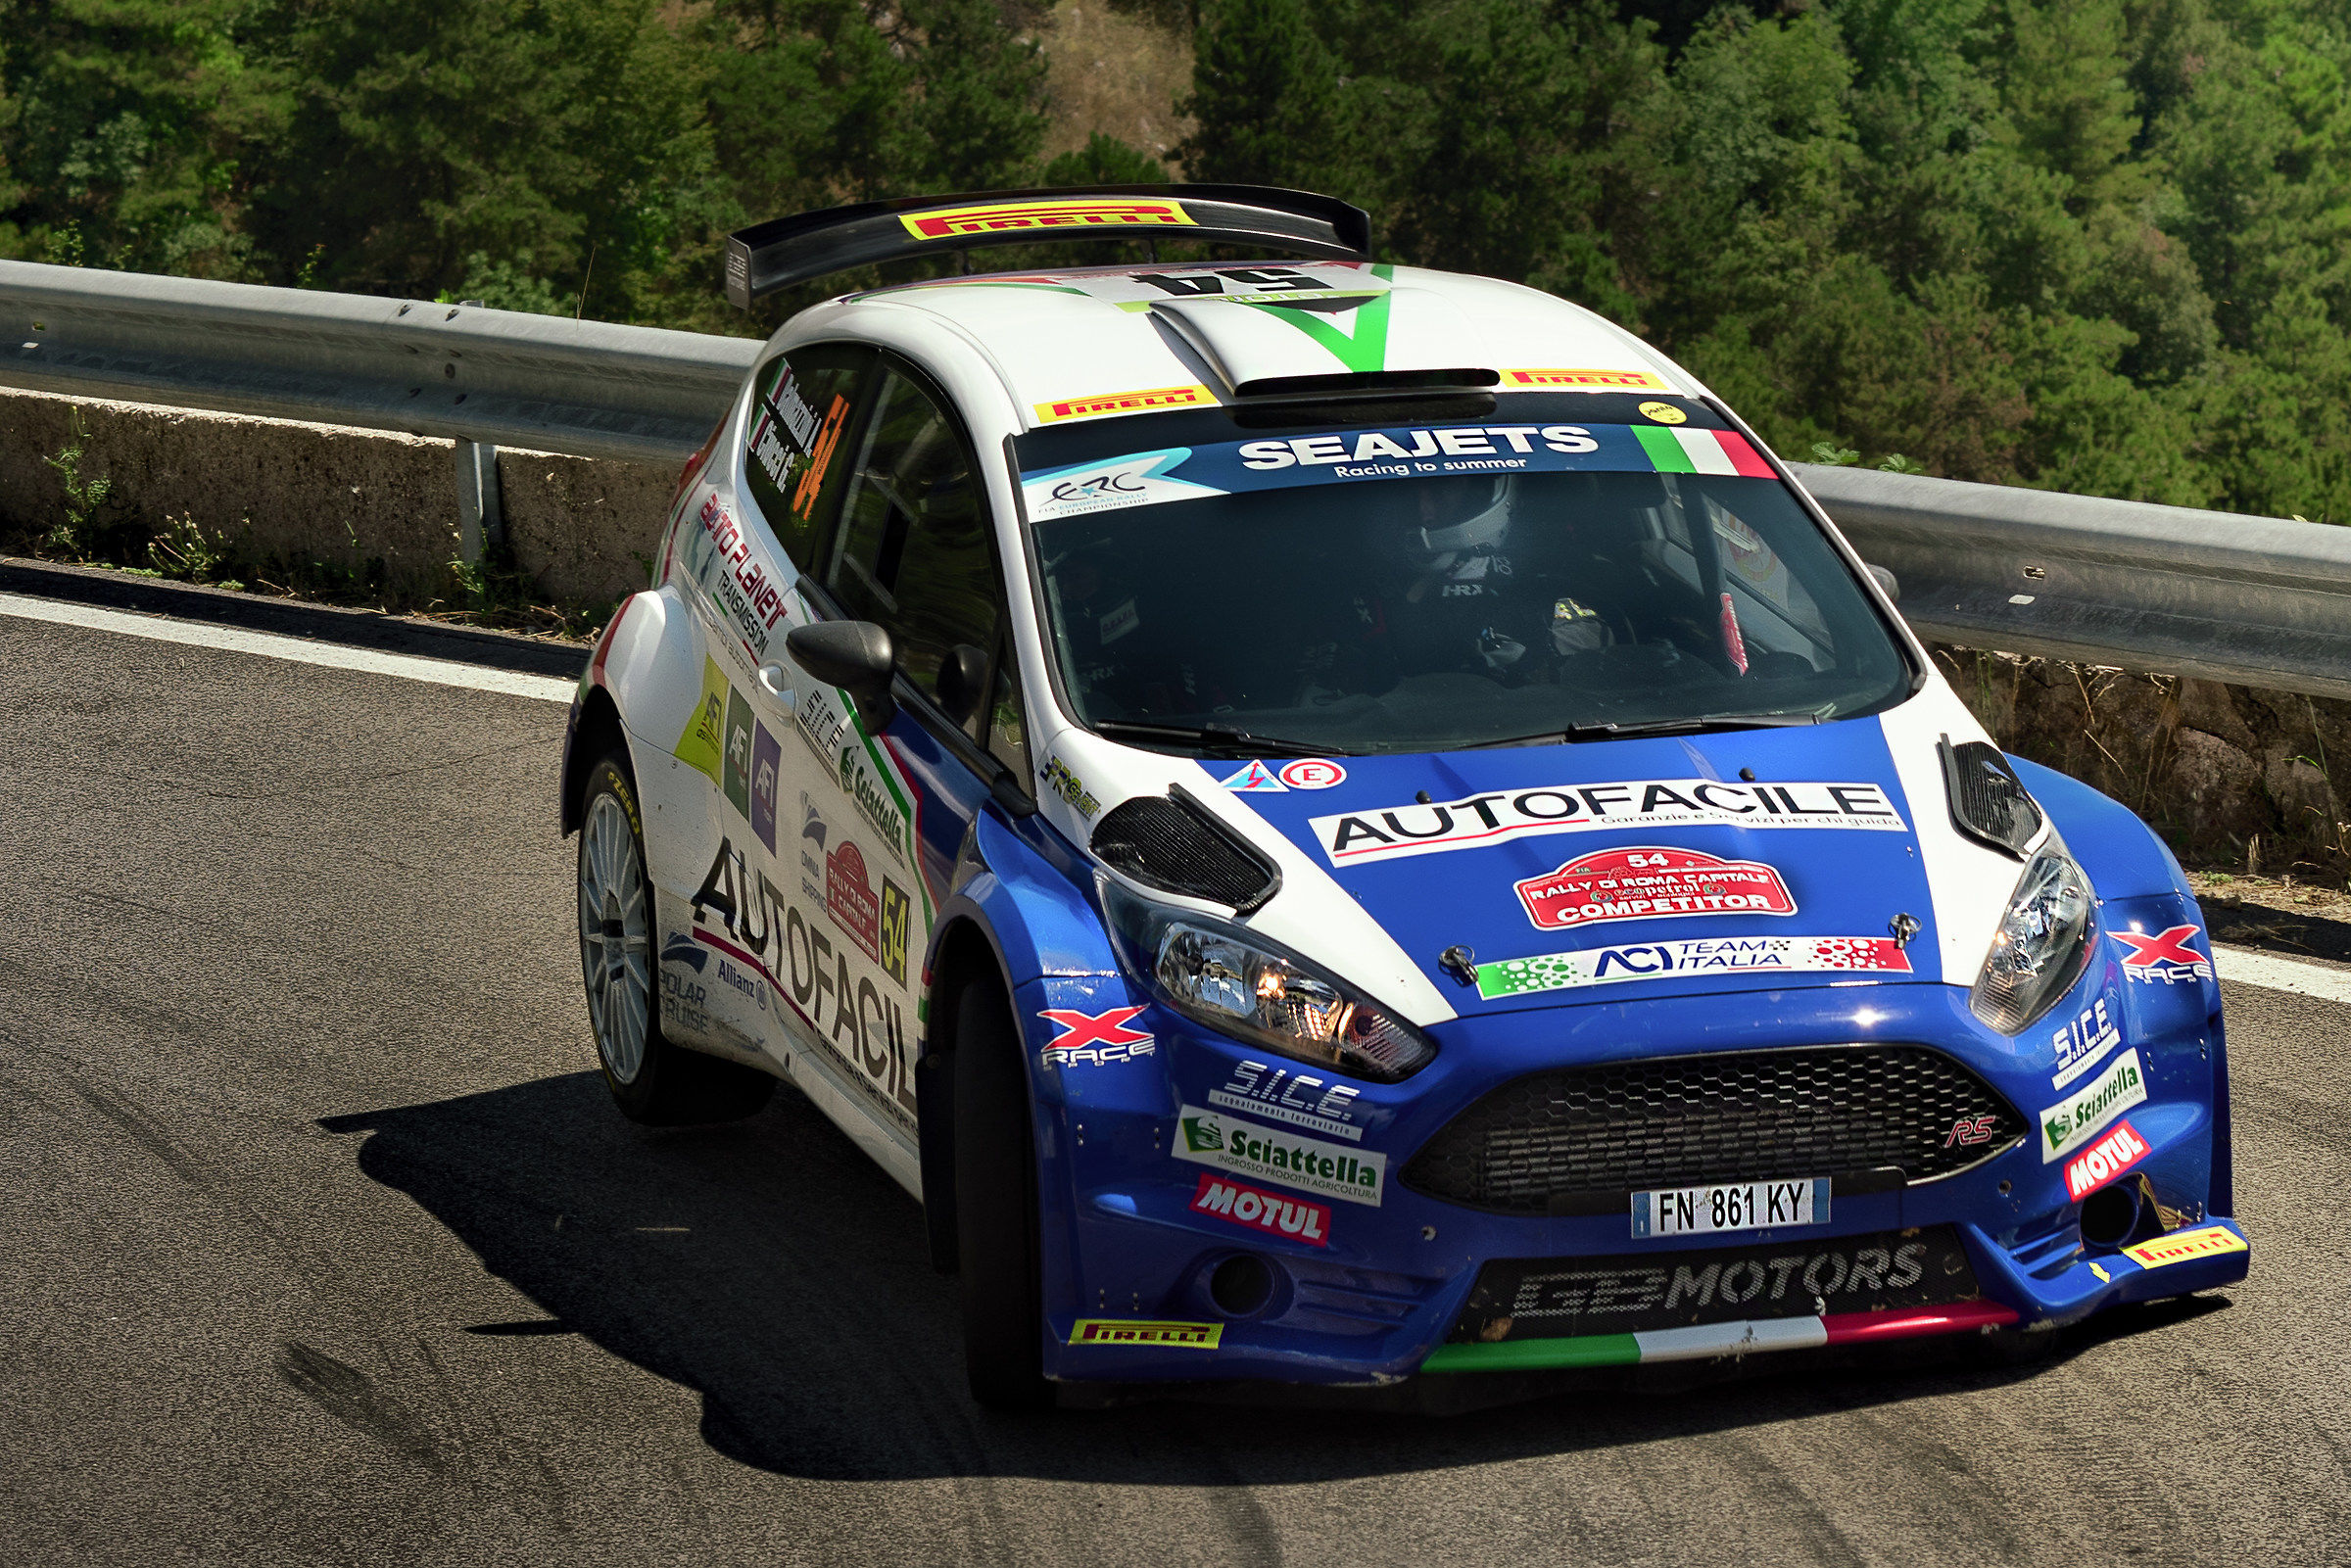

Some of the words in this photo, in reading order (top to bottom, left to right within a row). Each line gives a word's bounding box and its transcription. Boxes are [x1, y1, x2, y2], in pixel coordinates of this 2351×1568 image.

[914, 206, 1180, 237] PIRELLI
[1128, 268, 1334, 296] 54
[1511, 371, 1650, 387] PIRELLI
[1052, 386, 1197, 417] PIRELLI
[1238, 426, 1600, 471] SEAJETS
[1334, 462, 1410, 479] Racing
[1415, 460, 1438, 473] to
[1443, 457, 1528, 471] summer
[717, 570, 770, 657] TRANSMISSION
[729, 724, 747, 775] AFI
[755, 758, 775, 808] AFI
[1302, 767, 1321, 782] E
[854, 765, 903, 856] Sciattella
[1331, 784, 1894, 852] AUTOFACILE
[1602, 814, 1688, 825] Garanzie
[1780, 816, 1811, 826] per
[1847, 817, 1901, 828] guida
[1626, 852, 1670, 869] 54
[1529, 880, 1593, 900] RALLY
[1599, 879, 1619, 889] DI
[1621, 875, 1680, 888] ROMA
[1684, 873, 1770, 884] CAPITALE
[1556, 894, 1773, 923] COMPETITOR
[883, 886, 907, 982] 54
[1679, 941, 1767, 955] TEAM
[1594, 946, 1674, 978] ACI
[1678, 954, 1783, 971] ITALIA
[2122, 964, 2214, 982] RACE
[717, 958, 755, 999] Allianz
[1041, 1039, 1156, 1066] RACE
[1224, 1060, 1361, 1121] S.I.C.E.
[2075, 1066, 2139, 1129] Sciattella
[1943, 1116, 1996, 1149] RS
[1229, 1129, 1377, 1189] Sciattella
[2070, 1126, 2144, 1198] MOTUL
[1218, 1154, 1264, 1174] INGROSSO
[1265, 1166, 1311, 1186] PRODOTTI
[1311, 1179, 1378, 1201] AGRICOLTURA
[1197, 1182, 1323, 1241] MOTUL
[1658, 1190, 1695, 1232] FN
[1711, 1185, 1755, 1228] 861
[1766, 1182, 1805, 1224] KY
[2135, 1233, 2233, 1263] PIRELLI
[1082, 1323, 1211, 1344] PIRELLI
